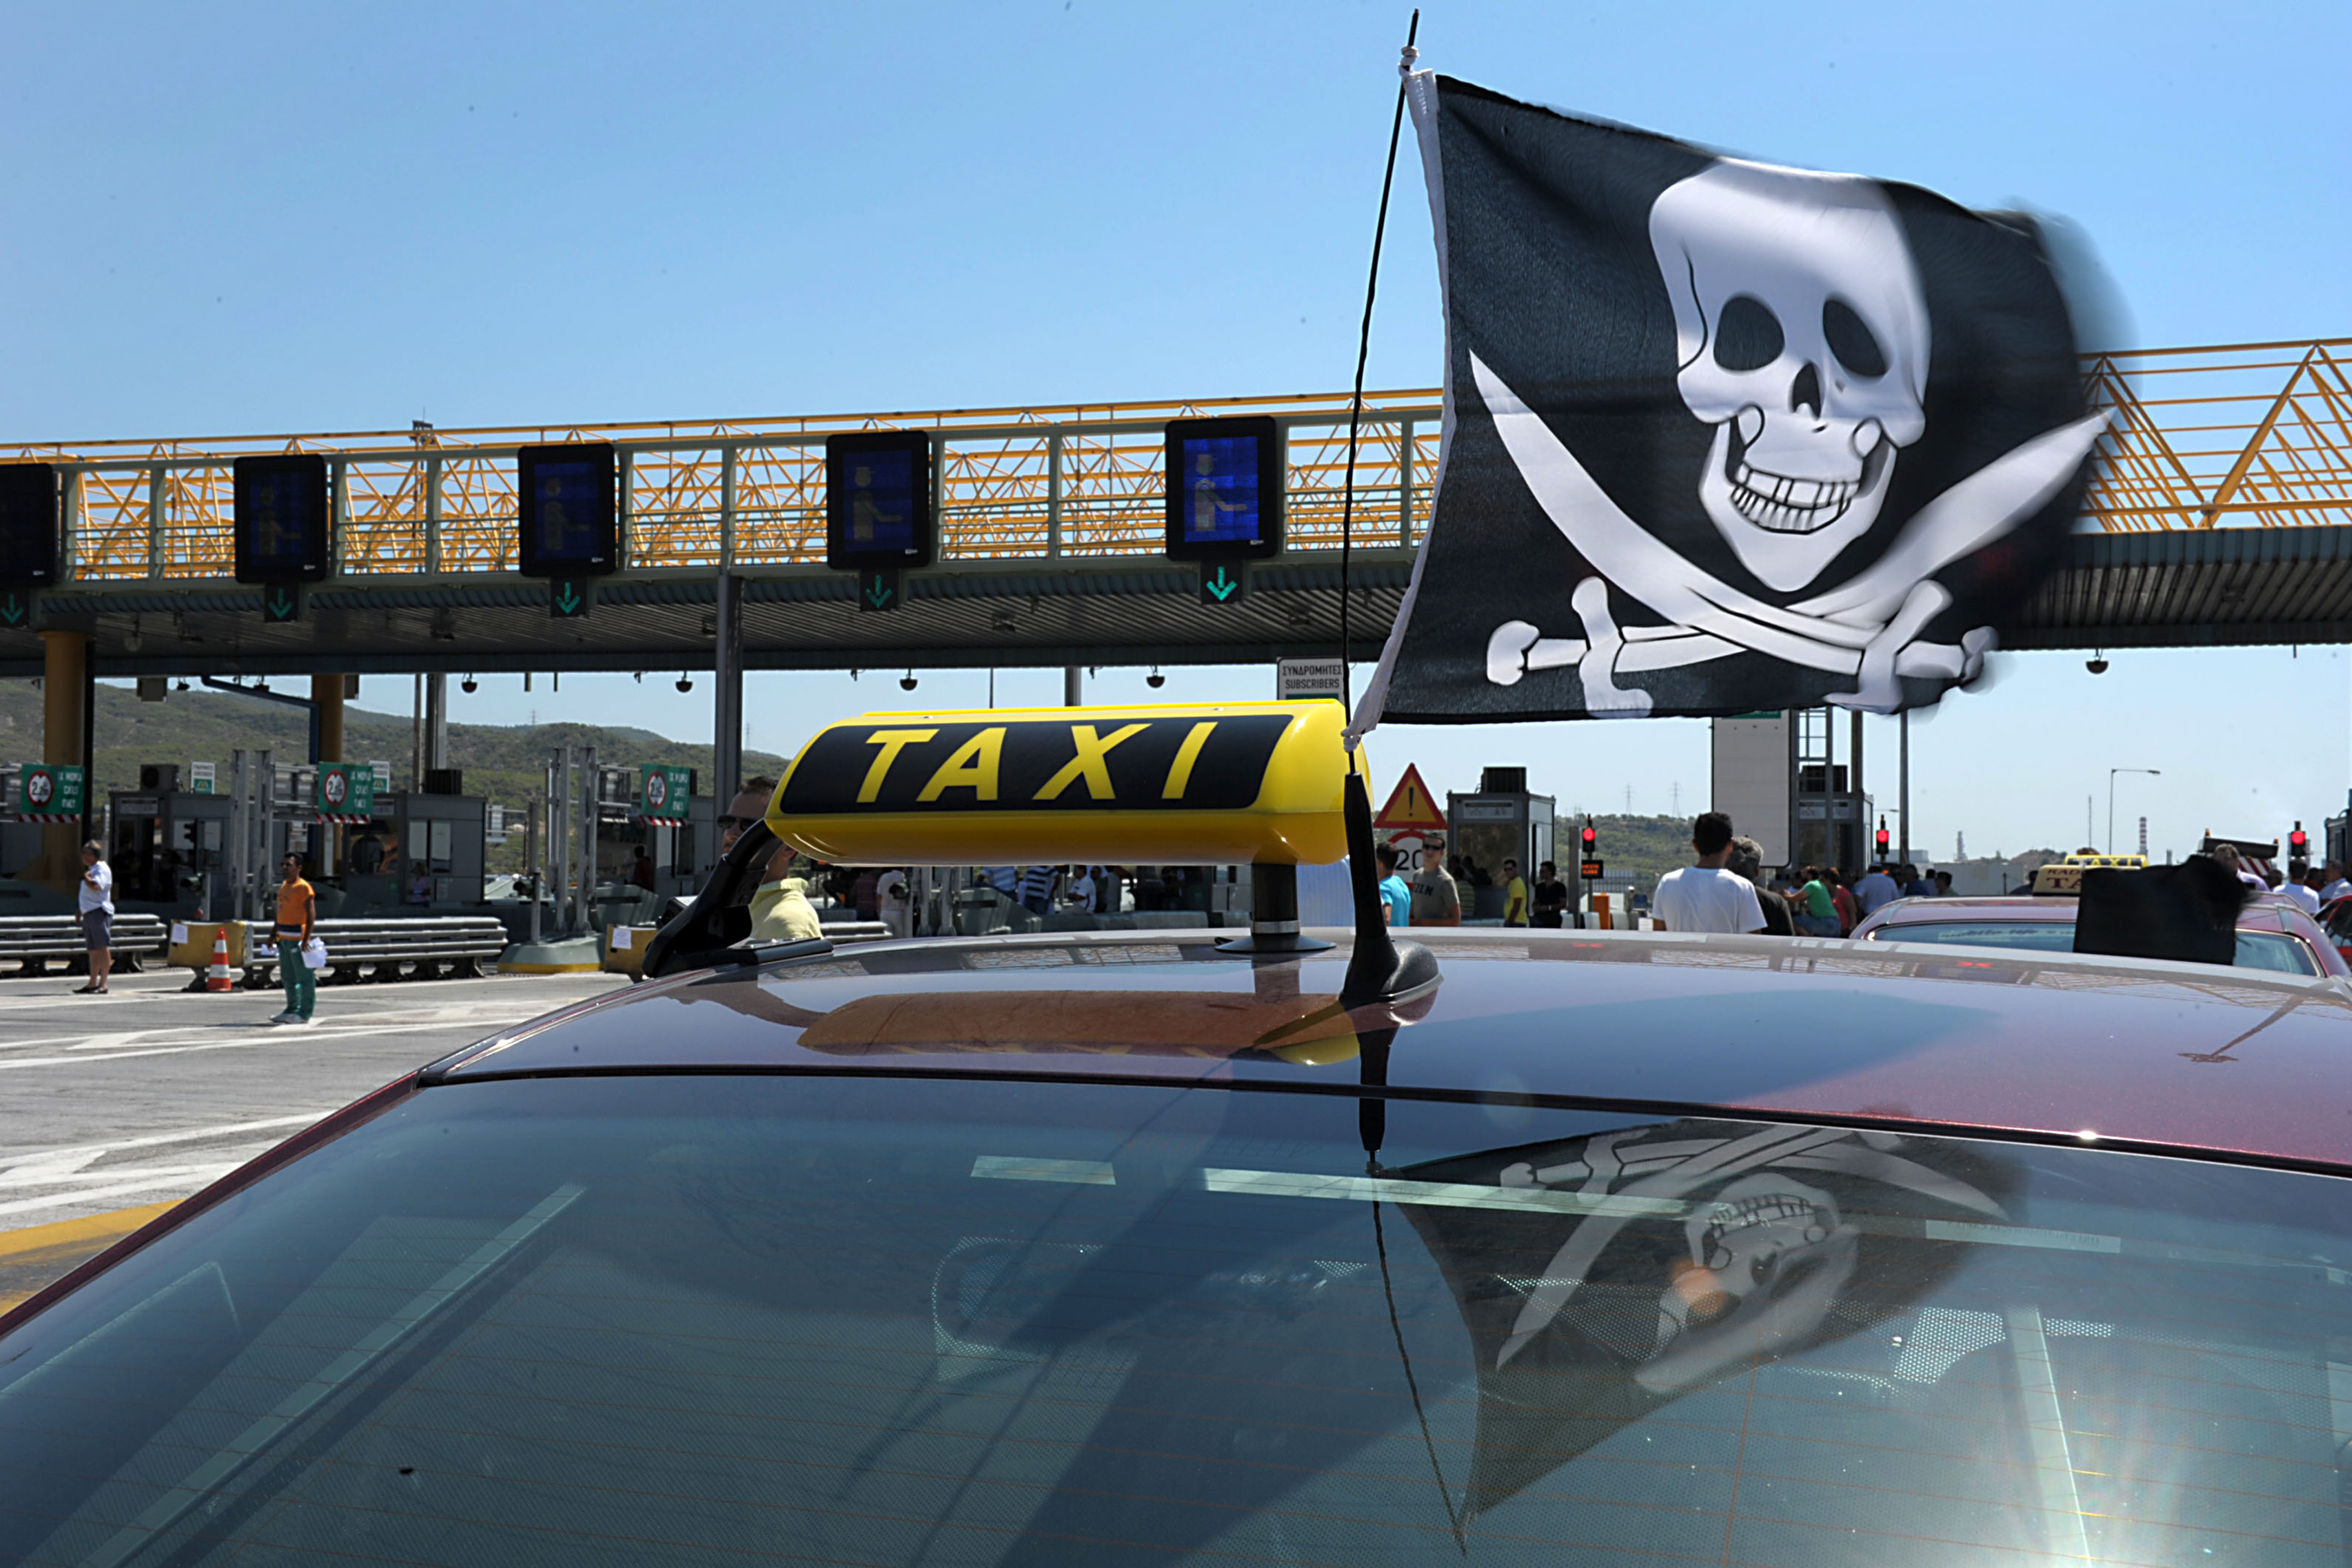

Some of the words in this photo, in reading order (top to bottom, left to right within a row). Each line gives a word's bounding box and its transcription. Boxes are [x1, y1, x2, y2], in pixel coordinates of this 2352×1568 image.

[1282, 665, 1342, 676] ΣΥΝΔΡΟΜΗΤΕΣ
[1285, 678, 1340, 689] SUBSCRIBERS
[856, 722, 1218, 803] TAXI
[1395, 849, 1423, 870] 20
